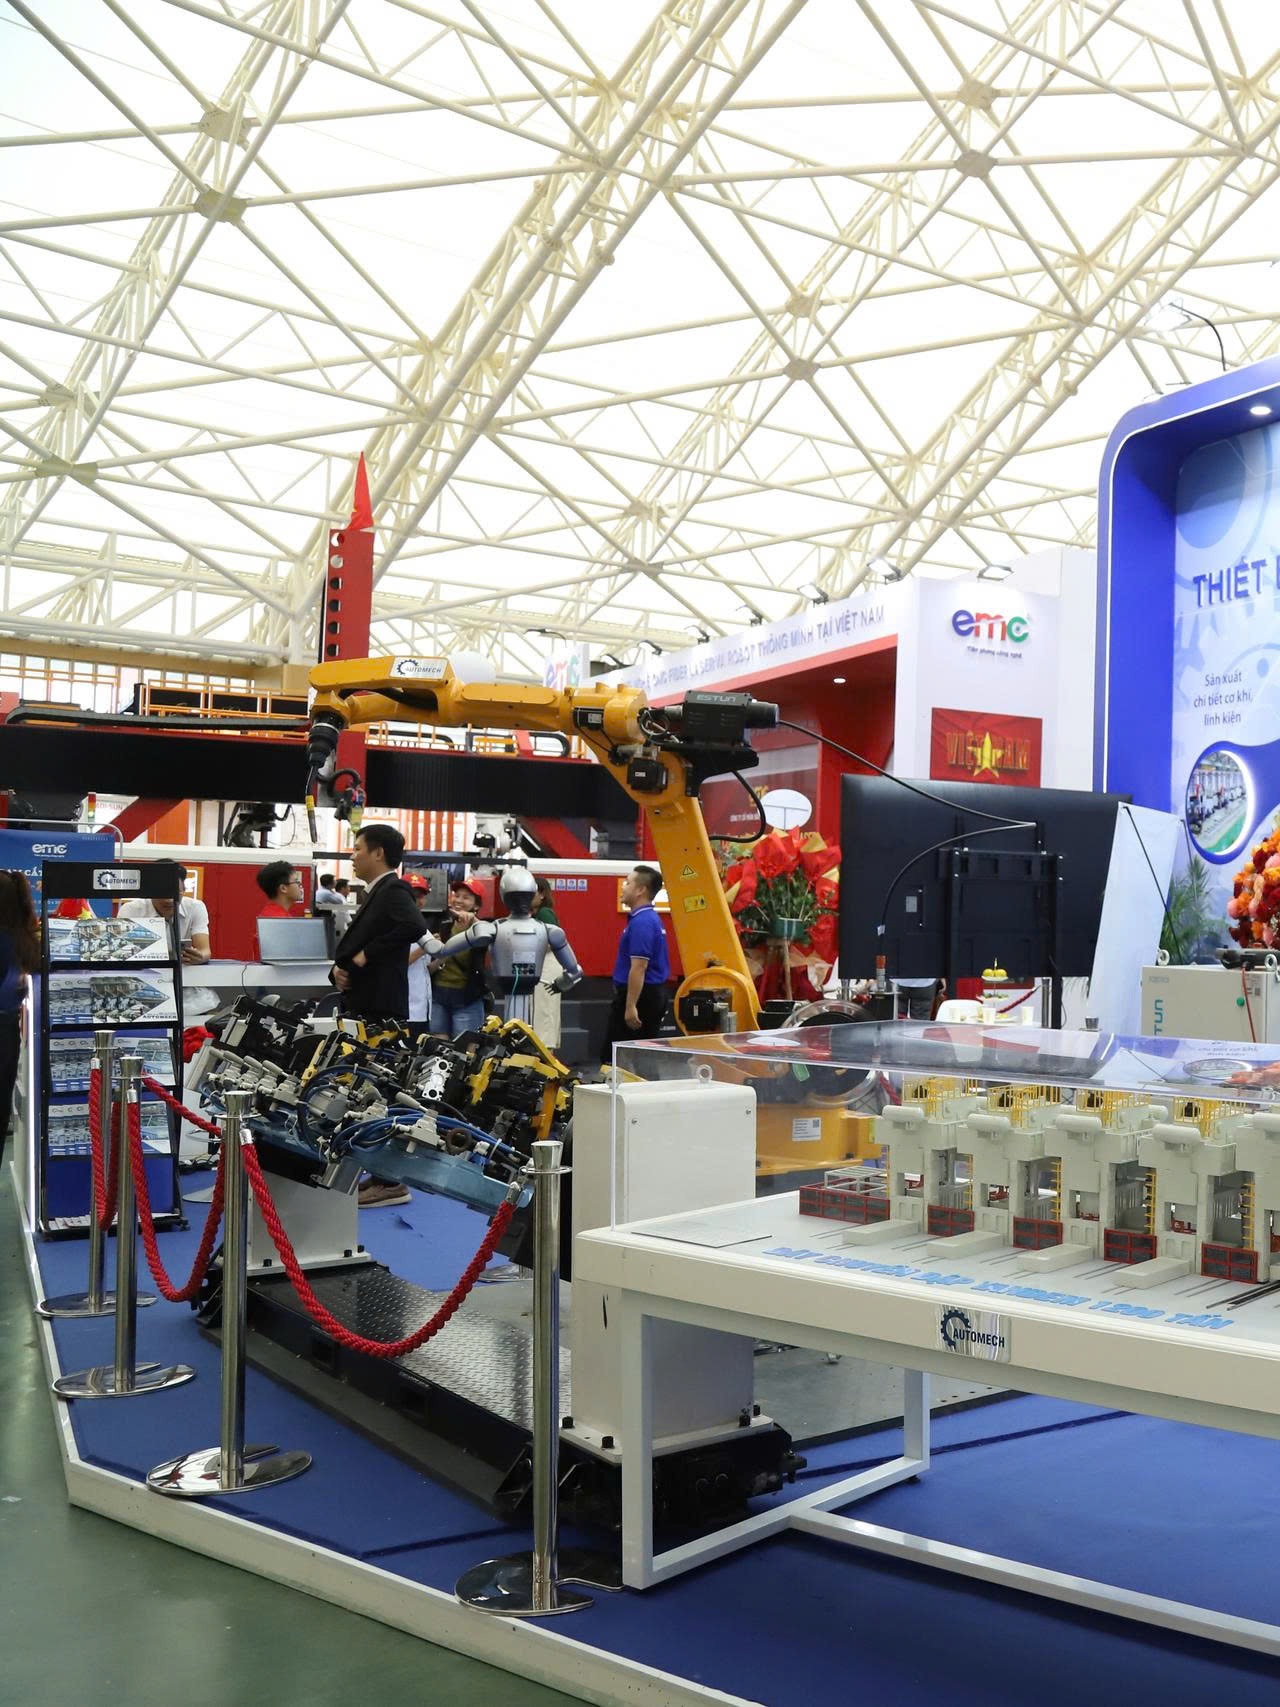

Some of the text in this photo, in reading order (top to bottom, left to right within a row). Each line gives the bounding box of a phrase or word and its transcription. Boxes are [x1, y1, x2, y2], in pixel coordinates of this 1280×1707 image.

[1192, 553, 1267, 608] THIẾT
[951, 609, 1030, 643] emc
[1204, 667, 1243, 686] Sản xuất
[1193, 692, 1208, 708] chi
[1208, 690, 1224, 707] tiết
[1204, 710, 1243, 727] linh kiện
[32, 843, 68, 854] emc
[953, 1328, 1005, 1348] AUTOMECH
